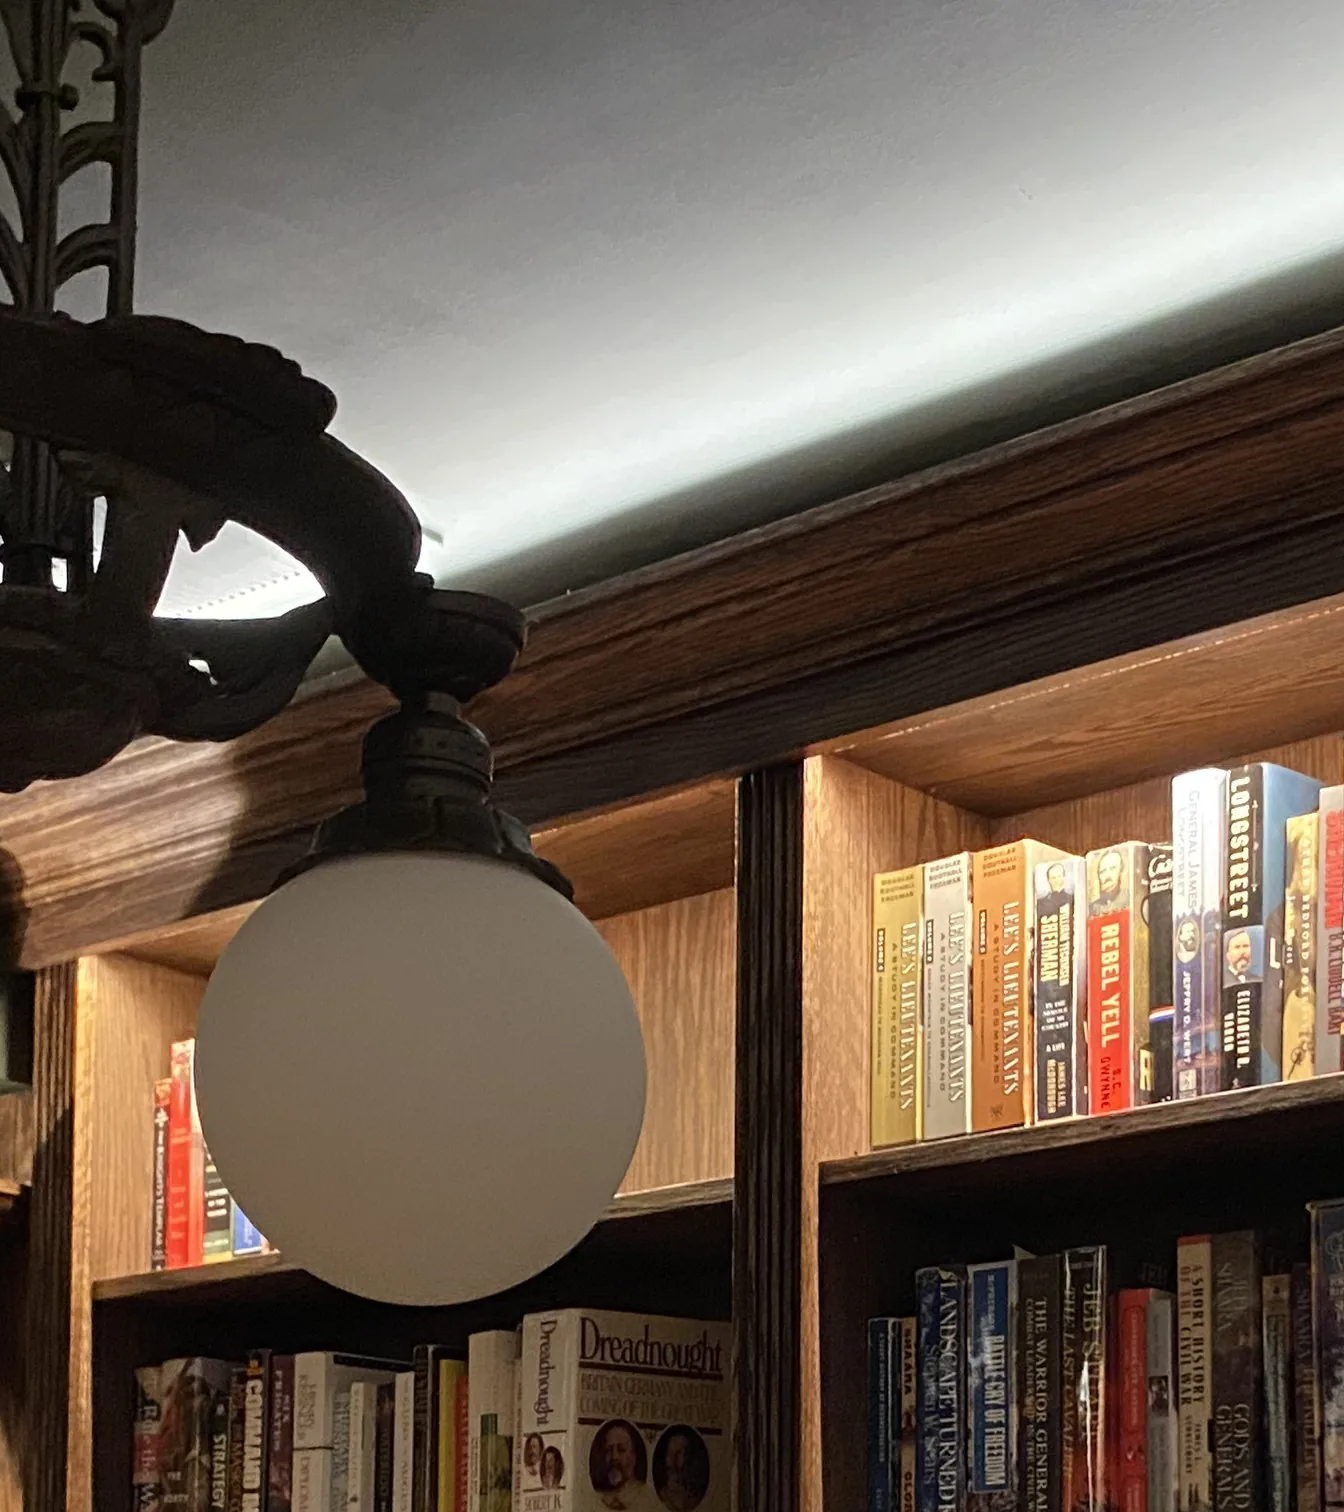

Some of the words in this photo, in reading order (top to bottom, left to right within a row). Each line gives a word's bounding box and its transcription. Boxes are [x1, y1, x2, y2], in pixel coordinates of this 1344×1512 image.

[1229, 777, 1251, 919] LONGSTREET
[901, 922, 917, 974] LEE'S
[949, 914, 965, 965] LEE'S
[1003, 902, 1019, 955] LEE'S
[1040, 915, 1059, 982] SHERMAN
[1099, 922, 1120, 992] REBEL
[899, 981, 916, 1110] LIEUTENANTS
[947, 972, 965, 1103] LIEUTENANTS
[1003, 962, 1019, 1095] LIEUTENANTS
[1099, 997, 1121, 1049] YELL
[1035, 1299, 1048, 1333] THE
[1063, 1288, 1075, 1328] THE
[1083, 1283, 1102, 1334] JEB
[1191, 1278, 1205, 1328] SHORT
[532, 1319, 558, 1428] Dreadnought
[580, 1317, 723, 1374] Dreadnought
[939, 1281, 960, 1409] LANDSCAPE
[984, 1335, 1006, 1380] BATTLE
[1062, 1330, 1075, 1378] LAST
[1181, 1326, 1193, 1366] CIVIL
[1191, 1337, 1205, 1403] HISTORY
[983, 1381, 1005, 1405] CRY
[1035, 1339, 1047, 1424] WARRIOR
[1180, 1373, 1192, 1405] WAR
[243, 1378, 264, 1490] COMMAND
[983, 1408, 1005, 1424] OF
[1234, 1403, 1251, 1457] GODS
[212, 1433, 227, 1509] STRATEGY
[937, 1411, 960, 1500] TURNED
[983, 1426, 1005, 1486] FREEDOM
[1216, 1405, 1233, 1510] GENERALS
